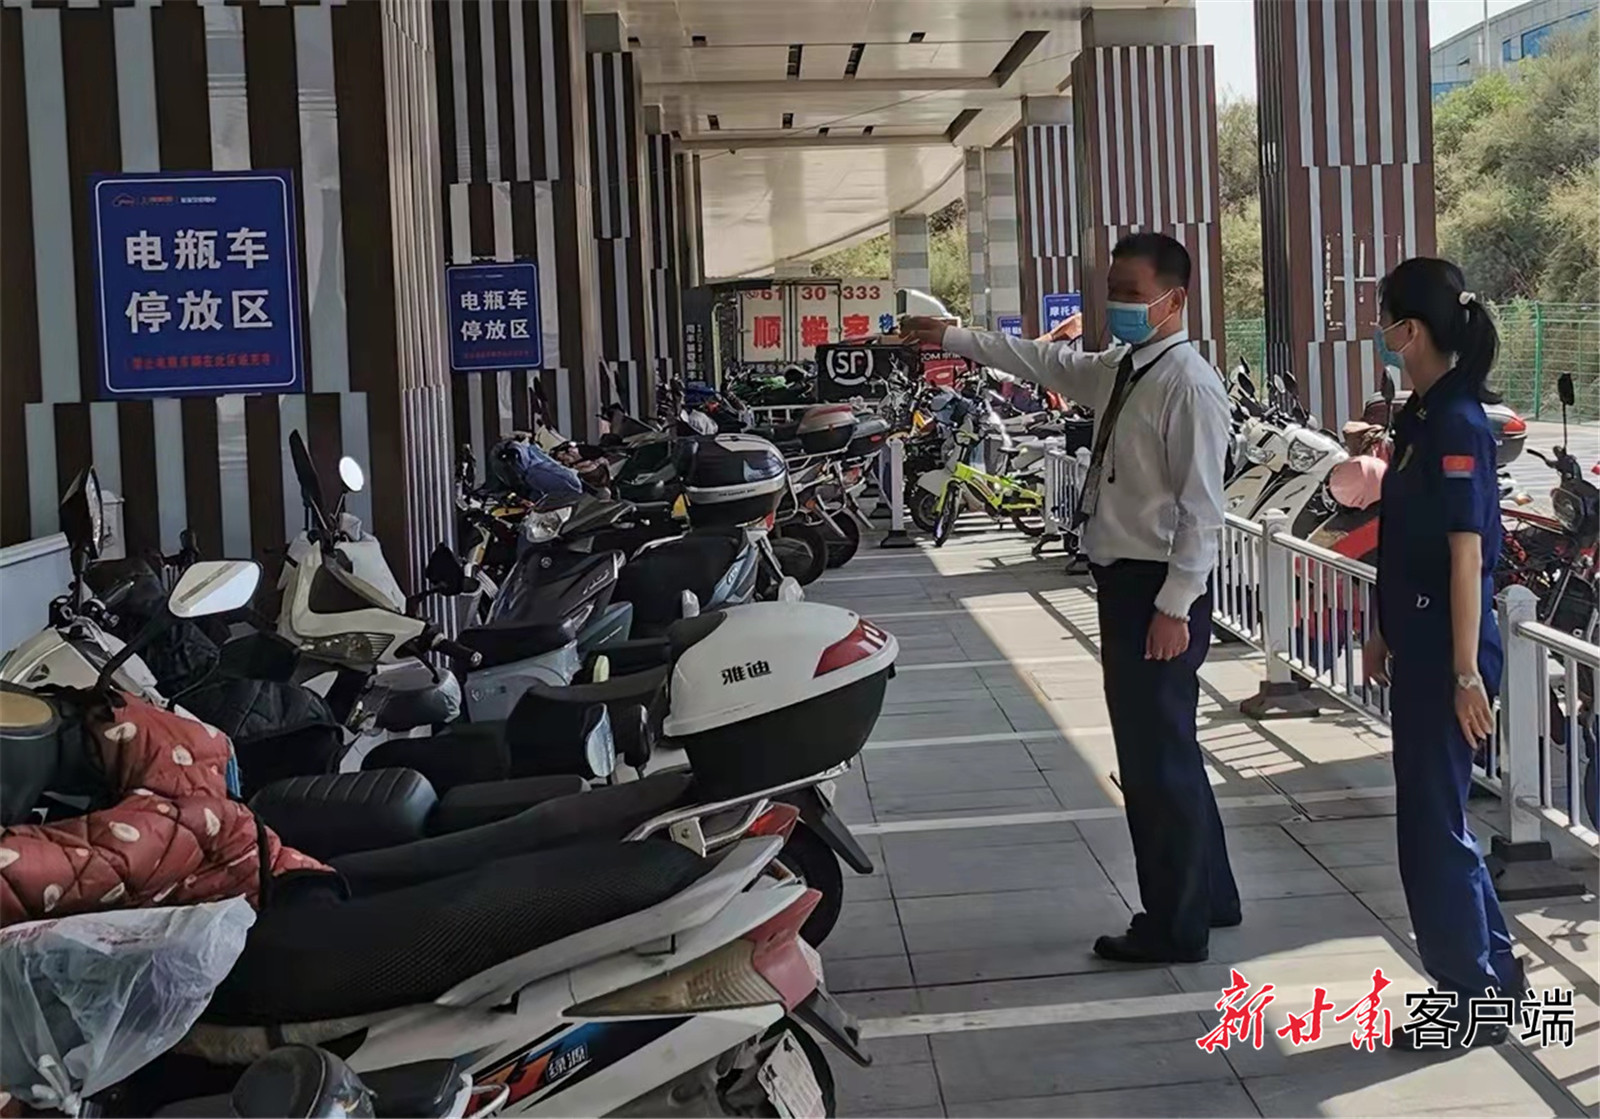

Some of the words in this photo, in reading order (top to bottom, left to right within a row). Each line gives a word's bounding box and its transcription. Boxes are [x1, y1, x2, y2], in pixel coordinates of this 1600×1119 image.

[126, 227, 269, 271] 电瓶车
[125, 289, 273, 333] 停放区
[460, 289, 528, 311] 电瓶车
[461, 319, 530, 341] 停放区
[721, 660, 772, 685] 雅迪
[548, 1044, 586, 1079] 绿源
